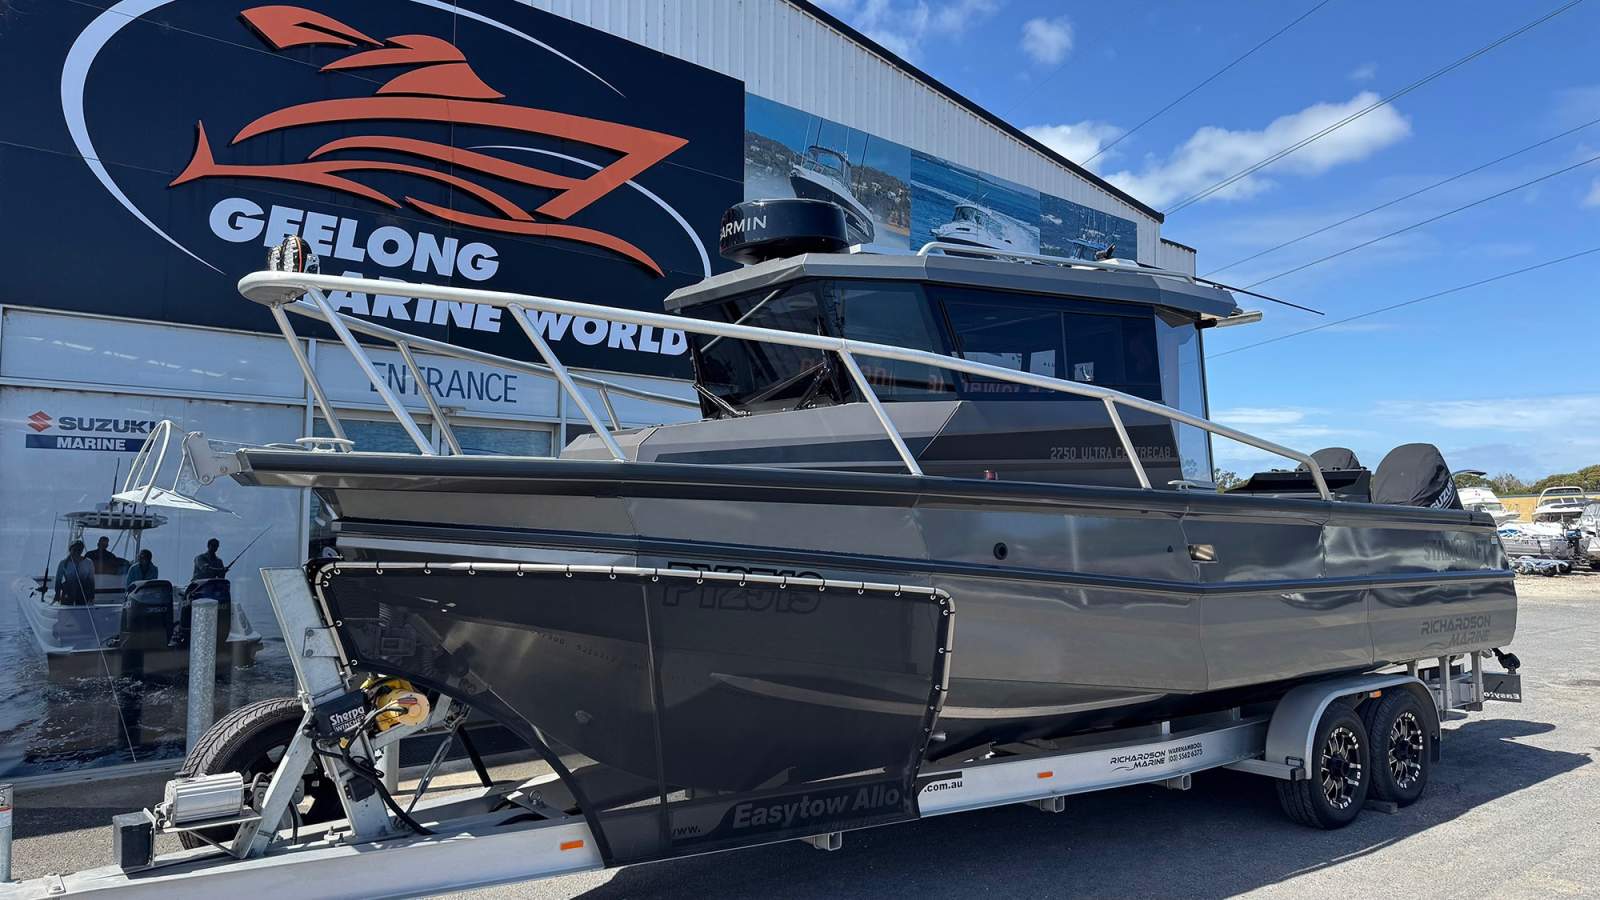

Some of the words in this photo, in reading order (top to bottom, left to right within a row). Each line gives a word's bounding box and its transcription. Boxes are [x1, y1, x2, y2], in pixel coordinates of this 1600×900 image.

[720, 215, 767, 240] ARMIN
[209, 198, 499, 281] GEELONG
[303, 271, 501, 333] ARINE
[523, 308, 688, 356] WORLD
[56, 437, 126, 451] MARINE
[1050, 447, 1077, 460] 2750
[1081, 446, 1113, 459] ULTRA
[1421, 616, 1491, 634] RICHARDSON
[1449, 630, 1490, 646] MARINE
[330, 706, 365, 726] Sherpa
[1110, 750, 1166, 764] RICHARDSON
[1133, 757, 1165, 769] MARINE
[924, 779, 963, 792] .com.au
[732, 794, 850, 829] Easytow
[852, 785, 901, 811] Allo
